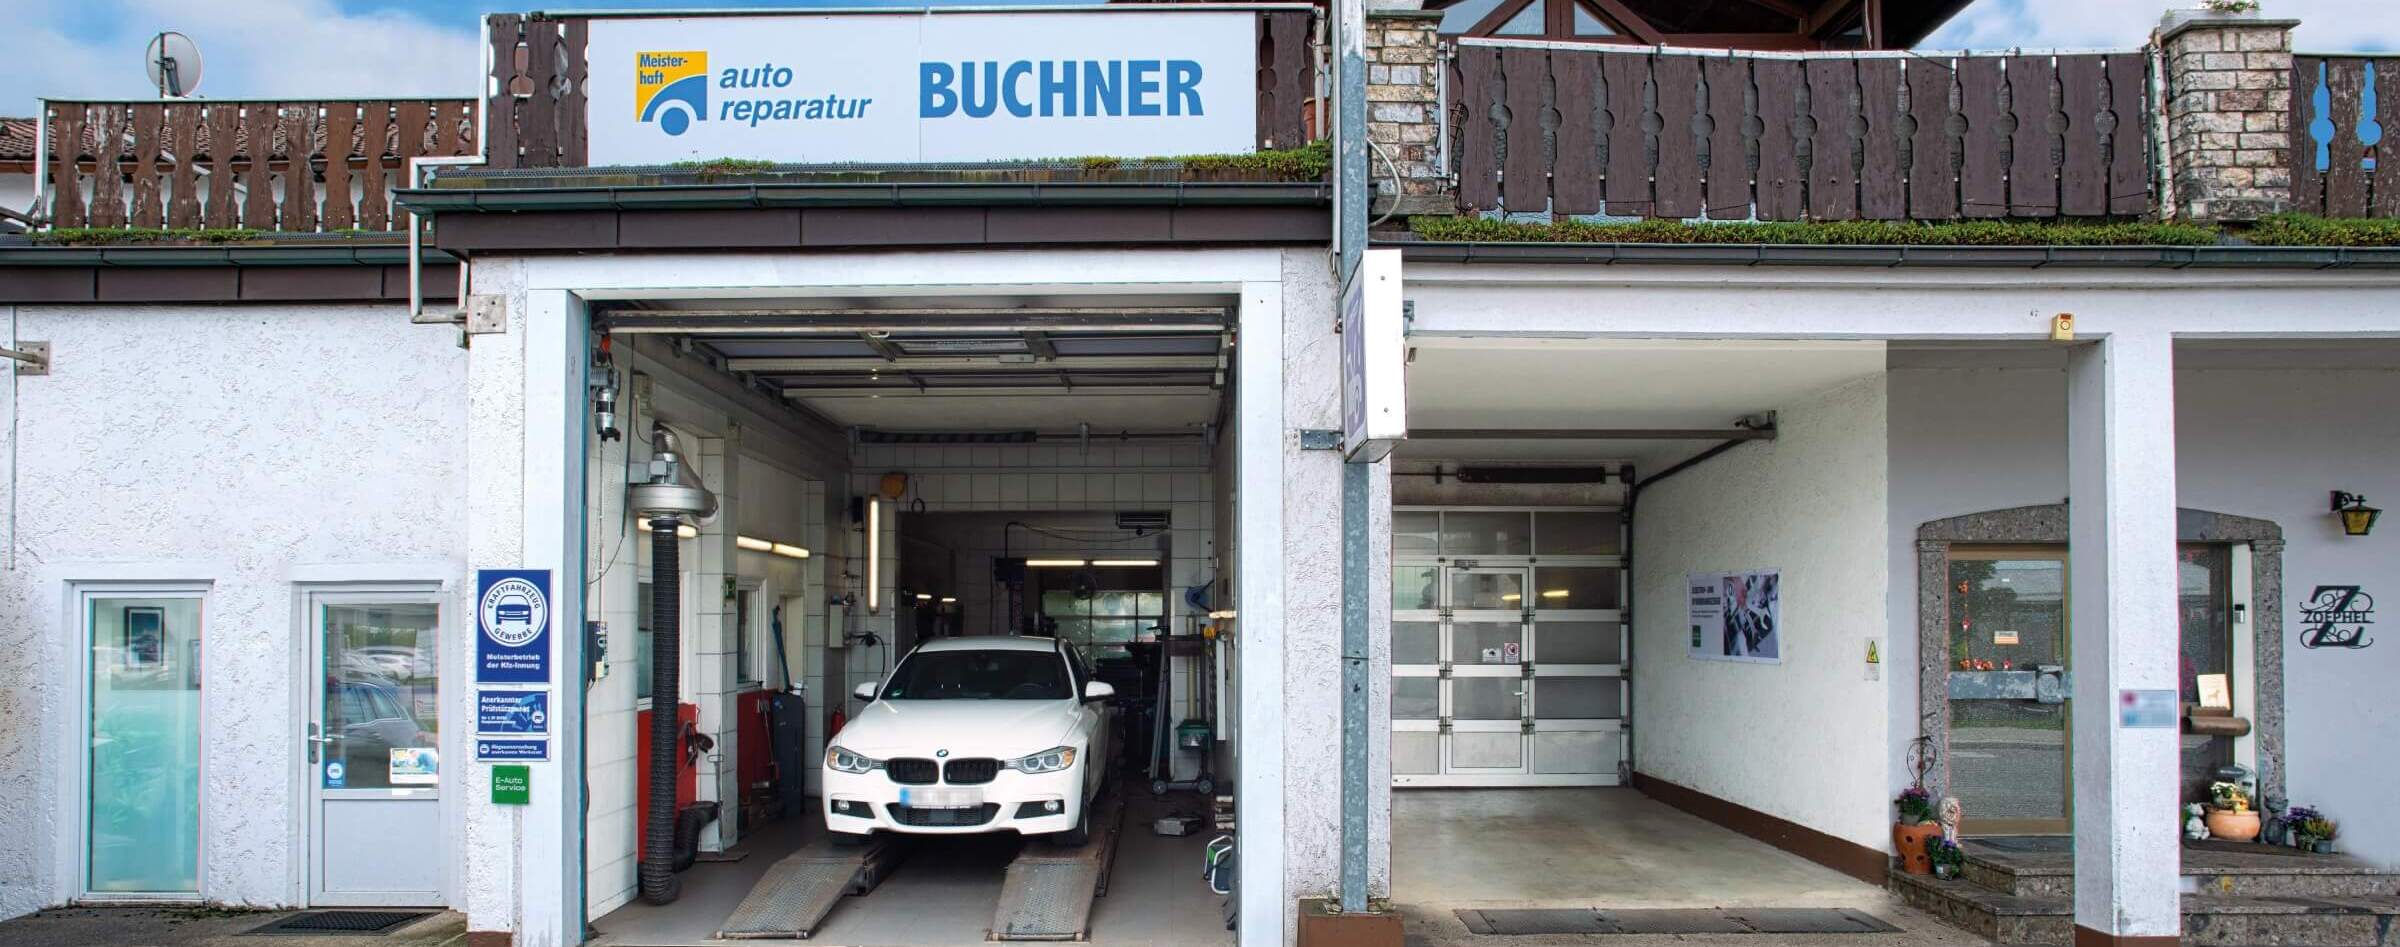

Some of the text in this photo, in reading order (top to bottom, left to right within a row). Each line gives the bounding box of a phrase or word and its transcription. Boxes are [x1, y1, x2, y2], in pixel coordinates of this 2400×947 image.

[639, 54, 688, 68] Meister-
[639, 71, 665, 85] haft
[719, 63, 793, 89] auto
[919, 60, 1205, 118] BUCHNER
[719, 94, 873, 128] reparatur
[487, 584, 541, 609] KRAFTFAHRZEUG
[2303, 611, 2372, 623] ZOEPHEL
[494, 627, 533, 641] GEWERBE
[486, 653, 541, 661] Meisterbetrieb
[481, 696, 523, 704] Anerkannter
[495, 776, 524, 785] E-Auto
